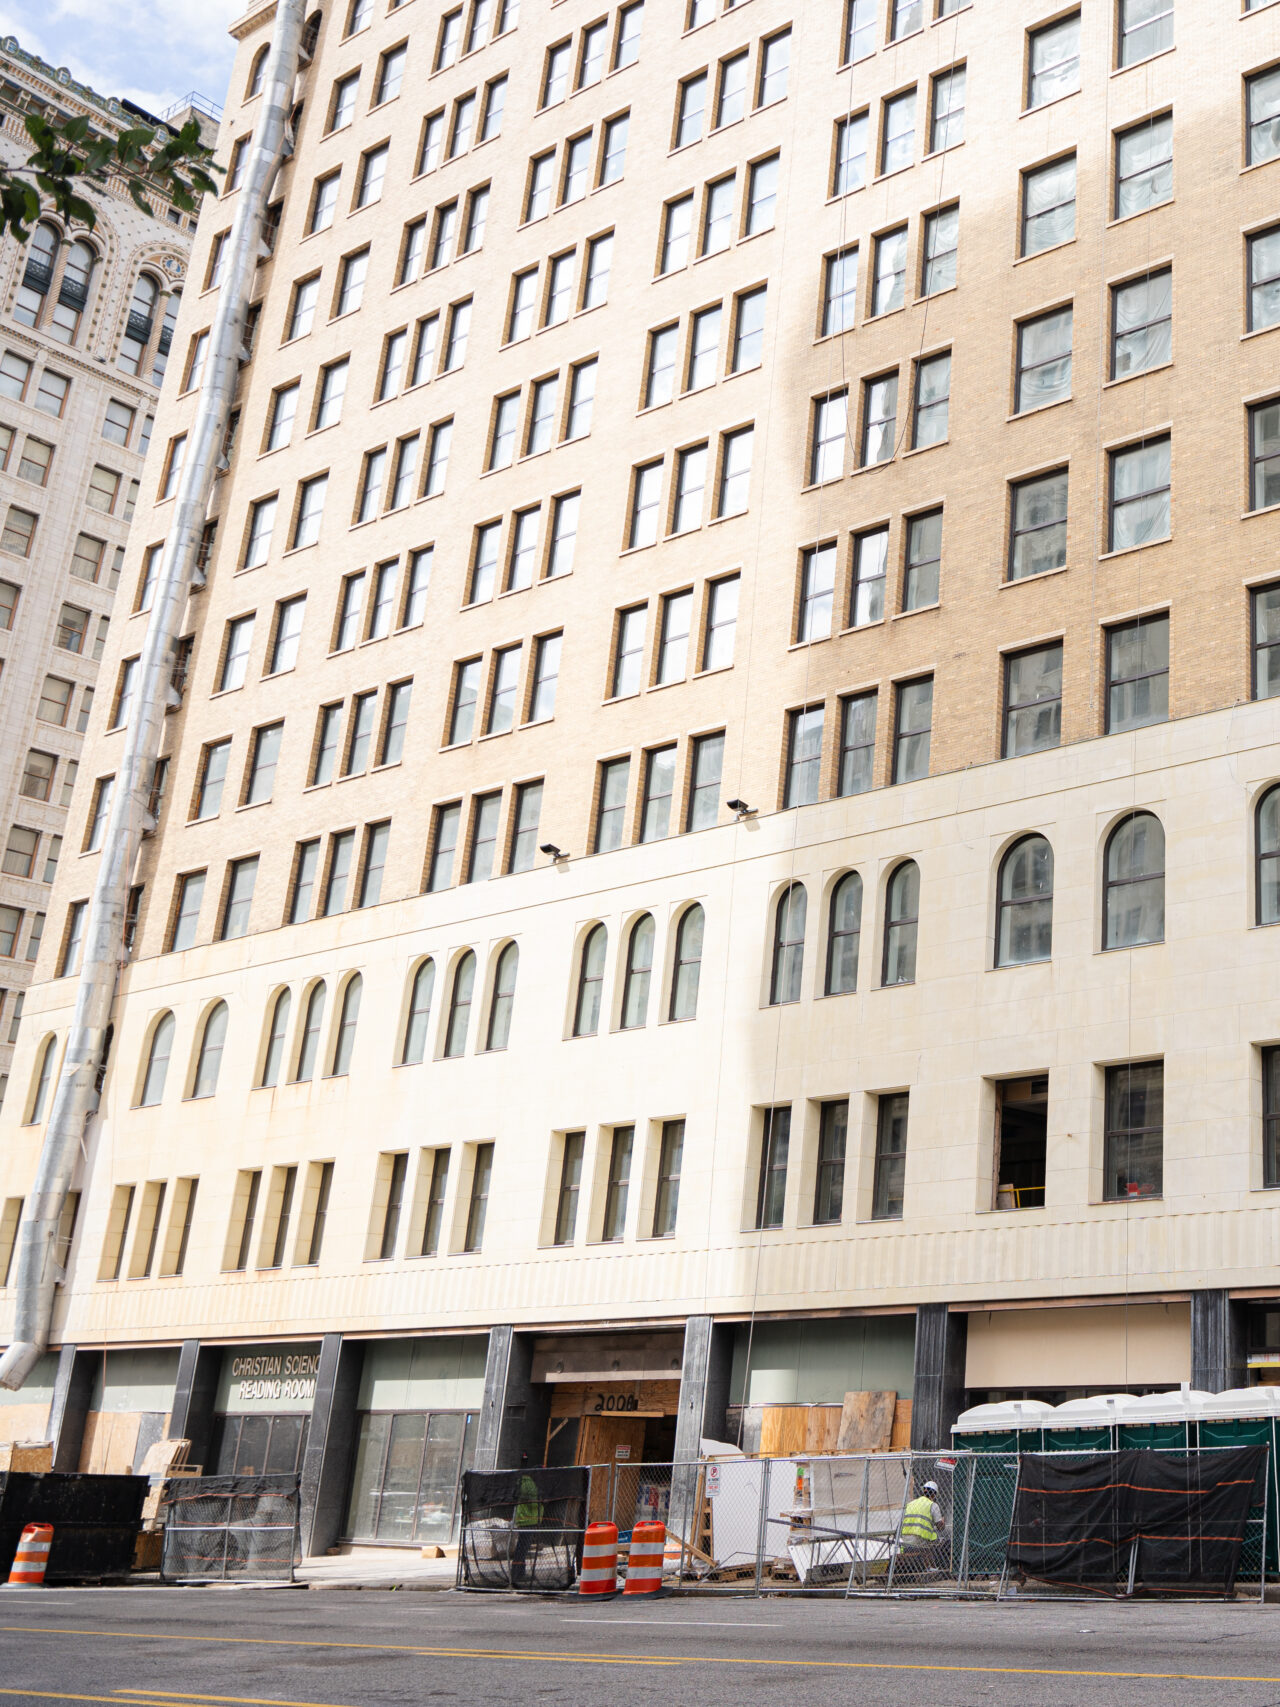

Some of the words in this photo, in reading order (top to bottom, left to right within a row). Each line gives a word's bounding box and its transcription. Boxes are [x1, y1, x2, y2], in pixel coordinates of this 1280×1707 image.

[232, 1356, 282, 1376] CHRISTIAN
[239, 1379, 281, 1399] READING
[284, 1378, 315, 1399] ROOM
